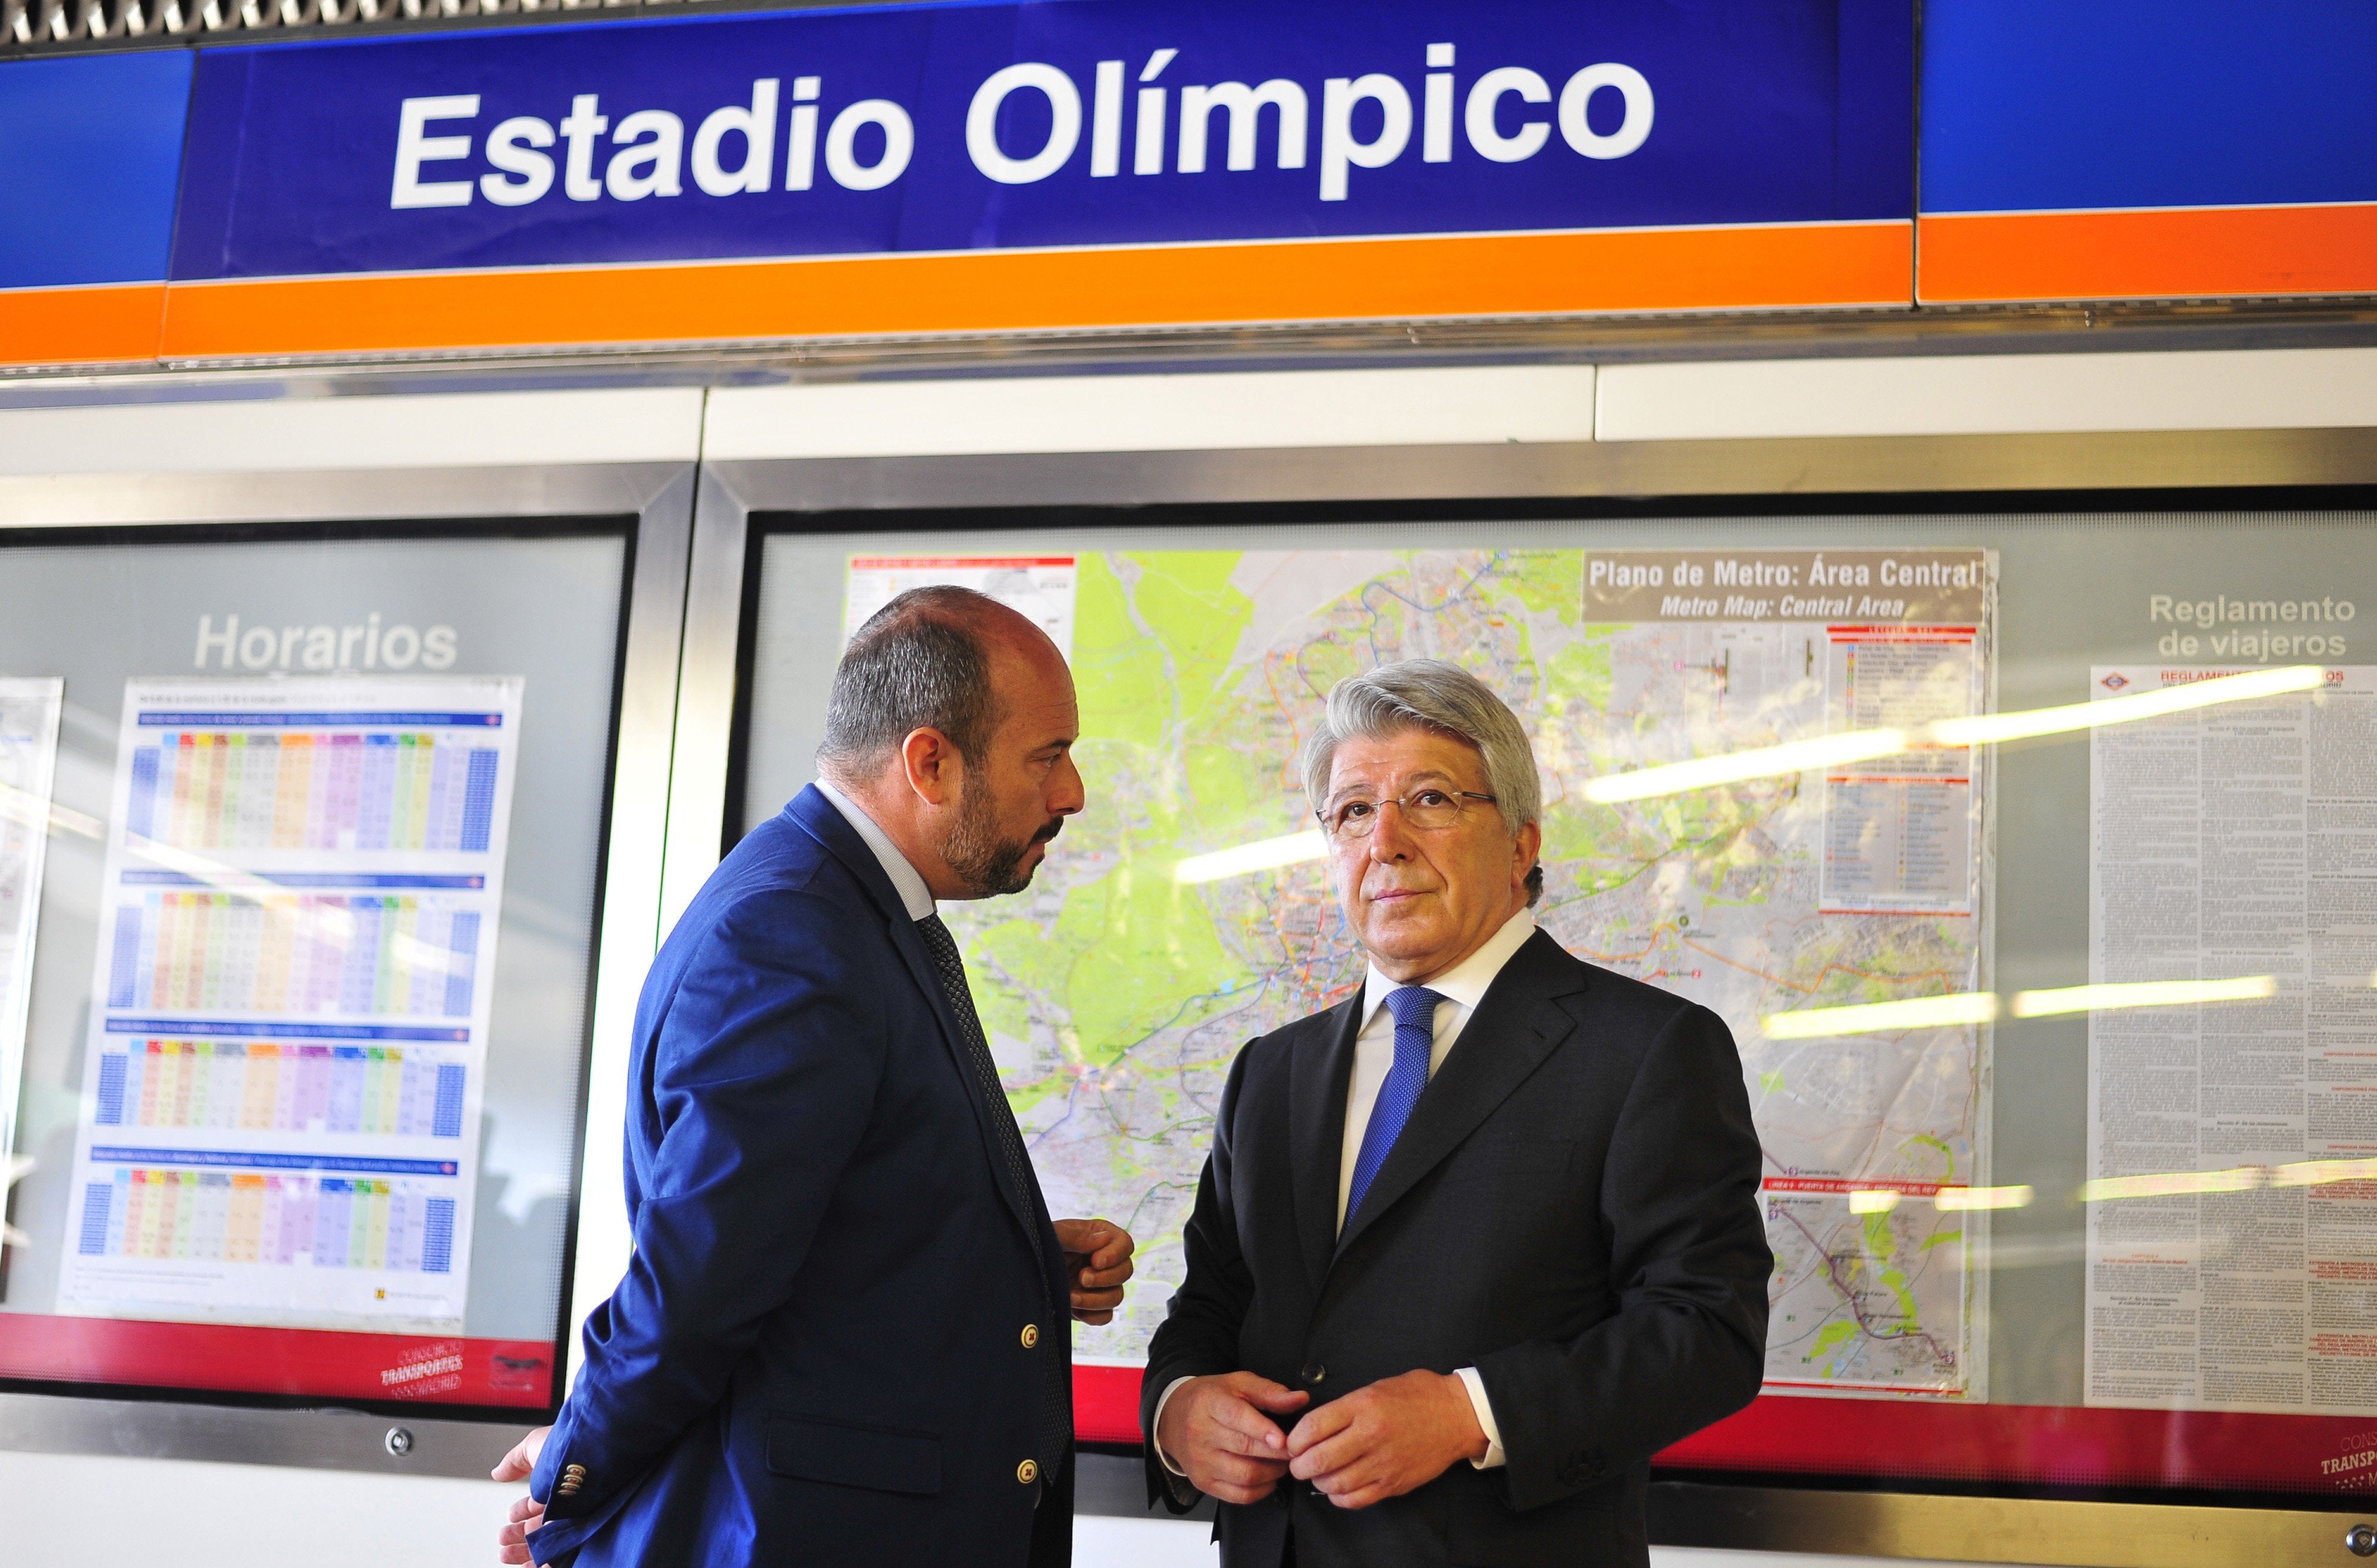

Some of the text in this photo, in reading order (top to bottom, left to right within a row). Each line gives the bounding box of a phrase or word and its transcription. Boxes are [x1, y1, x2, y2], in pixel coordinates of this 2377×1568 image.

[390, 42, 1655, 209] Estadio Olímpico
[1589, 553, 1977, 588] Plano de Metro: Área Central
[1660, 594, 1905, 620] Metro Map: Central Area
[2149, 594, 2356, 628] Reglamento
[194, 611, 458, 670] Horarios
[2158, 629, 2347, 662] de viajeros
[2321, 1450, 2377, 1475] TRANSP
